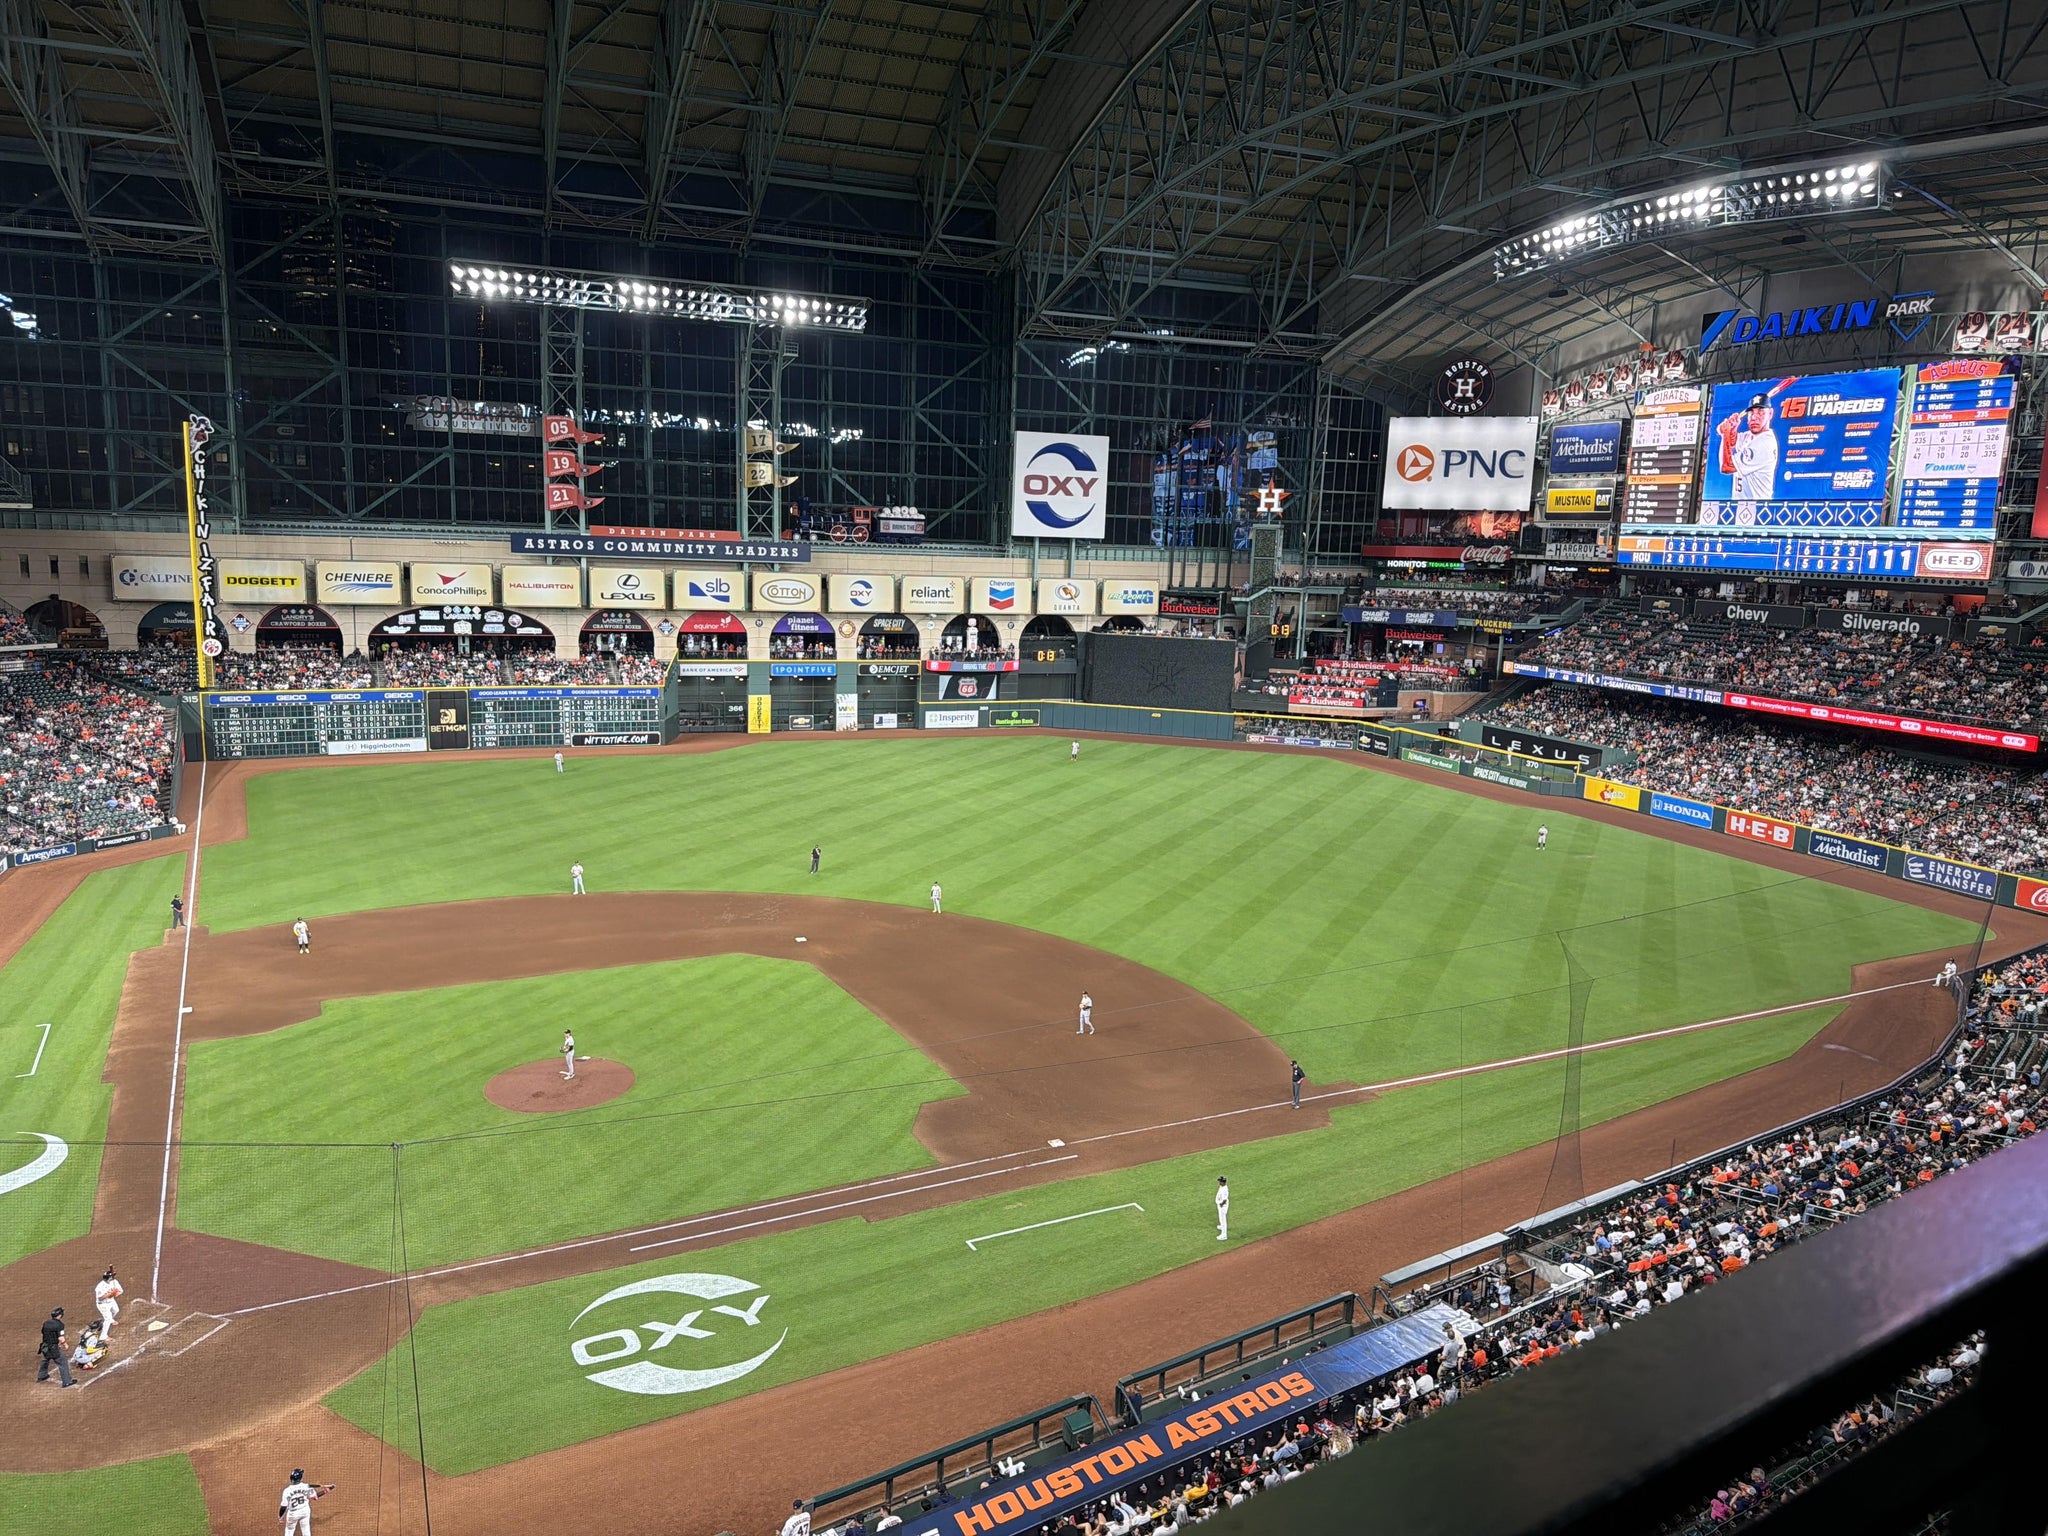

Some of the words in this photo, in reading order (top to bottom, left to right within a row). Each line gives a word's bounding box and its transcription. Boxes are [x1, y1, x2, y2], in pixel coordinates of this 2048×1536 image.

[1732, 299, 1879, 344] DAIKIN
[1886, 296, 1935, 317] PARK
[1957, 312, 1985, 335] 49
[1997, 309, 2029, 336] 24
[1445, 360, 1489, 378] HOUSTON
[1614, 364, 1632, 381] 33
[1639, 358, 1656, 374] 34
[1930, 359, 1988, 380] ASTROS
[1590, 373, 1607, 389] 25
[1455, 378, 1479, 398] H
[1566, 381, 1580, 397] 40
[1543, 389, 1558, 406] 32
[1653, 389, 1690, 404] PIRATES
[1813, 394, 1840, 402] ISAAC
[1929, 393, 1954, 401] Alvarez
[1445, 399, 1483, 412] ASTROS
[1780, 397, 1808, 418] 15
[1812, 398, 1885, 416] PAREDES
[1928, 403, 1951, 411] Walker
[426, 419, 476, 429] LUXURY
[481, 421, 528, 432] LIVING
[550, 419, 568, 434] 05
[751, 435, 766, 447] 17
[1555, 439, 1614, 457] Methodist
[552, 457, 570, 470] 19
[1441, 449, 1526, 479] PNC
[1933, 464, 1966, 472] DAIKIN
[750, 469, 766, 480] 22
[1023, 474, 1099, 497] OXY
[552, 490, 569, 501] 21
[1257, 488, 1284, 512] H
[1555, 495, 1591, 506] MUSTANG
[1596, 494, 1610, 507] CAT
[608, 528, 666, 537] DAIKIN
[524, 538, 595, 550] ASTROS
[604, 541, 716, 554] COMMUNITY
[724, 545, 800, 558] LEADERS
[1636, 539, 1649, 548] PIT
[1555, 543, 1599, 558] HARGROVE
[1632, 552, 1650, 562] HOU
[199, 543, 214, 572] IZ
[1387, 560, 1428, 568] HORNITOS
[1867, 549, 1877, 569] 1
[1883, 549, 1893, 570] 1
[1901, 550, 1911, 571] 1
[140, 573, 193, 583] CALPINE
[226, 576, 298, 586] DOGGETT
[324, 572, 393, 583] CHENIERE
[416, 585, 487, 597] ConocoPhillips
[509, 582, 574, 590] HALLIBURTON
[705, 578, 730, 593] slb
[766, 584, 807, 600] COTTON
[600, 592, 656, 601] LEXUS
[850, 590, 872, 598] OXY
[911, 587, 951, 598] reliant
[1122, 590, 1154, 604] LNG
[201, 576, 216, 637] FAIR
[1160, 601, 1219, 615] Budweiser
[280, 613, 315, 621] LANDRY'S
[787, 616, 814, 626] planet
[873, 618, 892, 628] SPACE
[892, 618, 906, 628] CITY
[1727, 605, 1768, 623] Chevy
[1843, 613, 1920, 634] Silverado
[693, 622, 719, 630] equinor
[791, 623, 819, 632] fitness
[1270, 624, 1290, 637] 0:13
[1475, 619, 1512, 629] PLUCKERS
[1384, 628, 1444, 640] Budweiser
[1037, 650, 1055, 661] 0:13
[1342, 660, 1386, 670] Budweiser
[1513, 663, 1539, 673] CHANDLER
[1587, 672, 1595, 684] K
[1623, 682, 1651, 693] FASTBALL
[182, 695, 199, 703] 315
[1310, 697, 1354, 706] Budweiser
[939, 713, 975, 722] Insperity
[430, 724, 467, 733] BETMGM
[1926, 725, 1939, 734] Here
[1940, 727, 1976, 740] Everything's
[1977, 733, 1997, 741] Better
[360, 742, 411, 750] Higginbotham
[584, 735, 649, 745] NITTOTIRE.COM
[1491, 736, 1590, 765] LEXUS
[1412, 753, 1431, 764] National
[1525, 760, 1539, 769] 370
[1473, 767, 1488, 779] SPACE
[1488, 770, 1500, 781] CITY
[1663, 802, 1711, 822] HONDA
[104, 834, 135, 846] PRIZEPICKS
[1816, 835, 1842, 845] HOUSTON
[21, 846, 69, 863] AmegyBank
[1814, 841, 1880, 867] Methodist
[1928, 861, 1981, 882] ENERGY
[1928, 872, 1992, 896] TRANSFER
[571, 1295, 771, 1366] OXY
[953, 1433, 1164, 1536] HOUSTON
[1164, 1371, 1316, 1450] ASTROS
